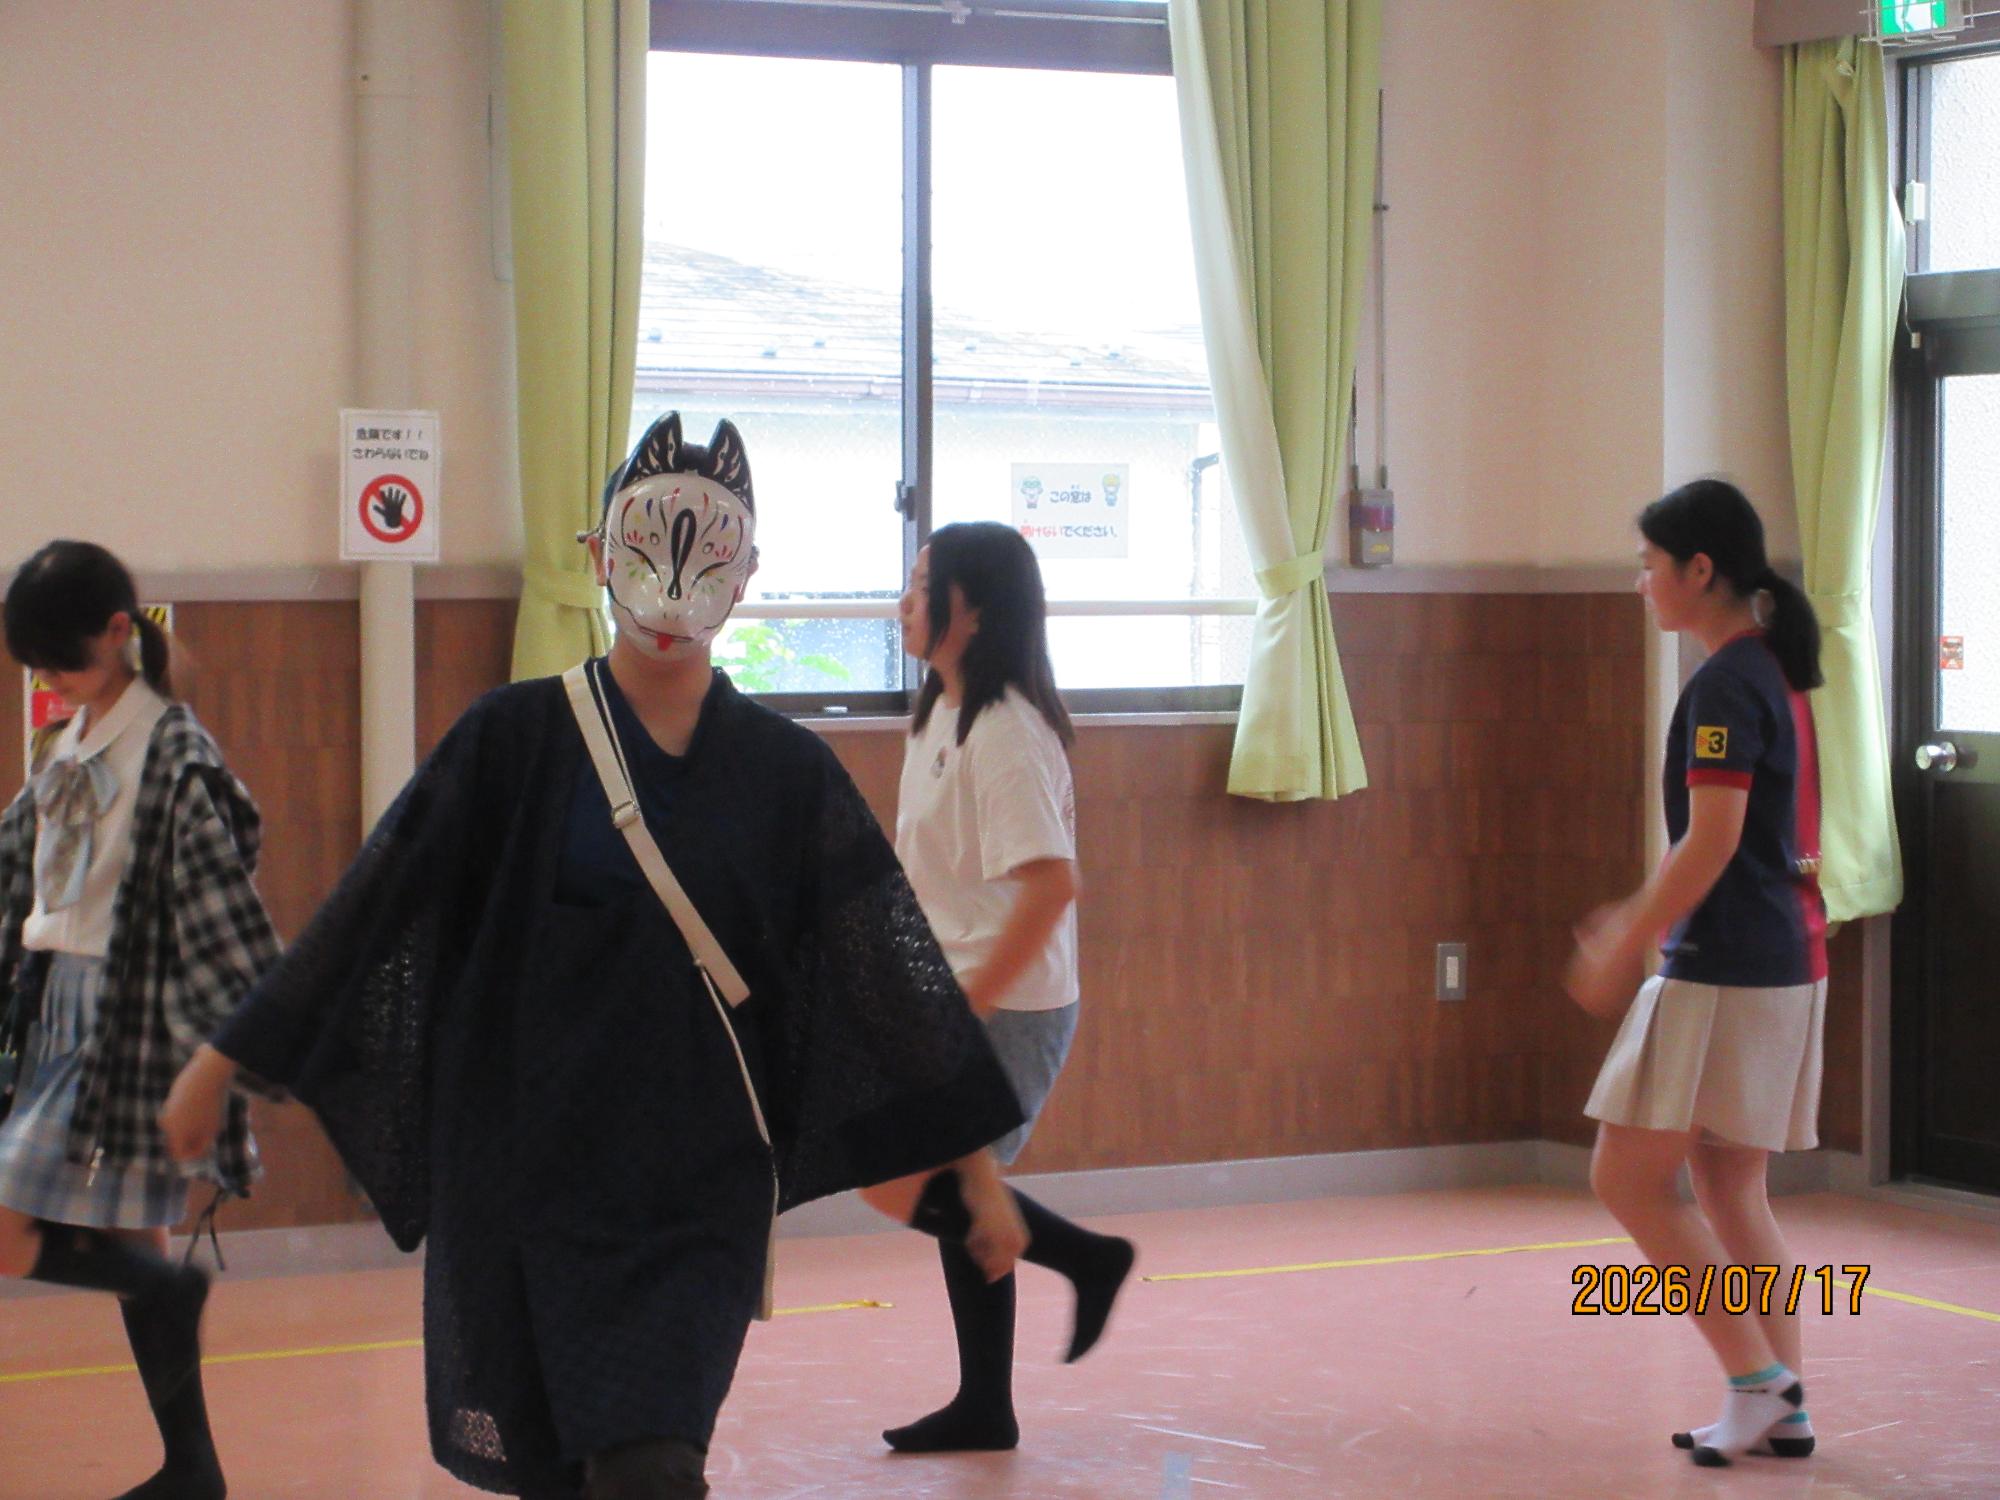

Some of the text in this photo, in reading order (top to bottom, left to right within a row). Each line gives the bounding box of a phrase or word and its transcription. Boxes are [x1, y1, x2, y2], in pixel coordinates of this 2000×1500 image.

[352, 448, 429, 461] さわらないでね
